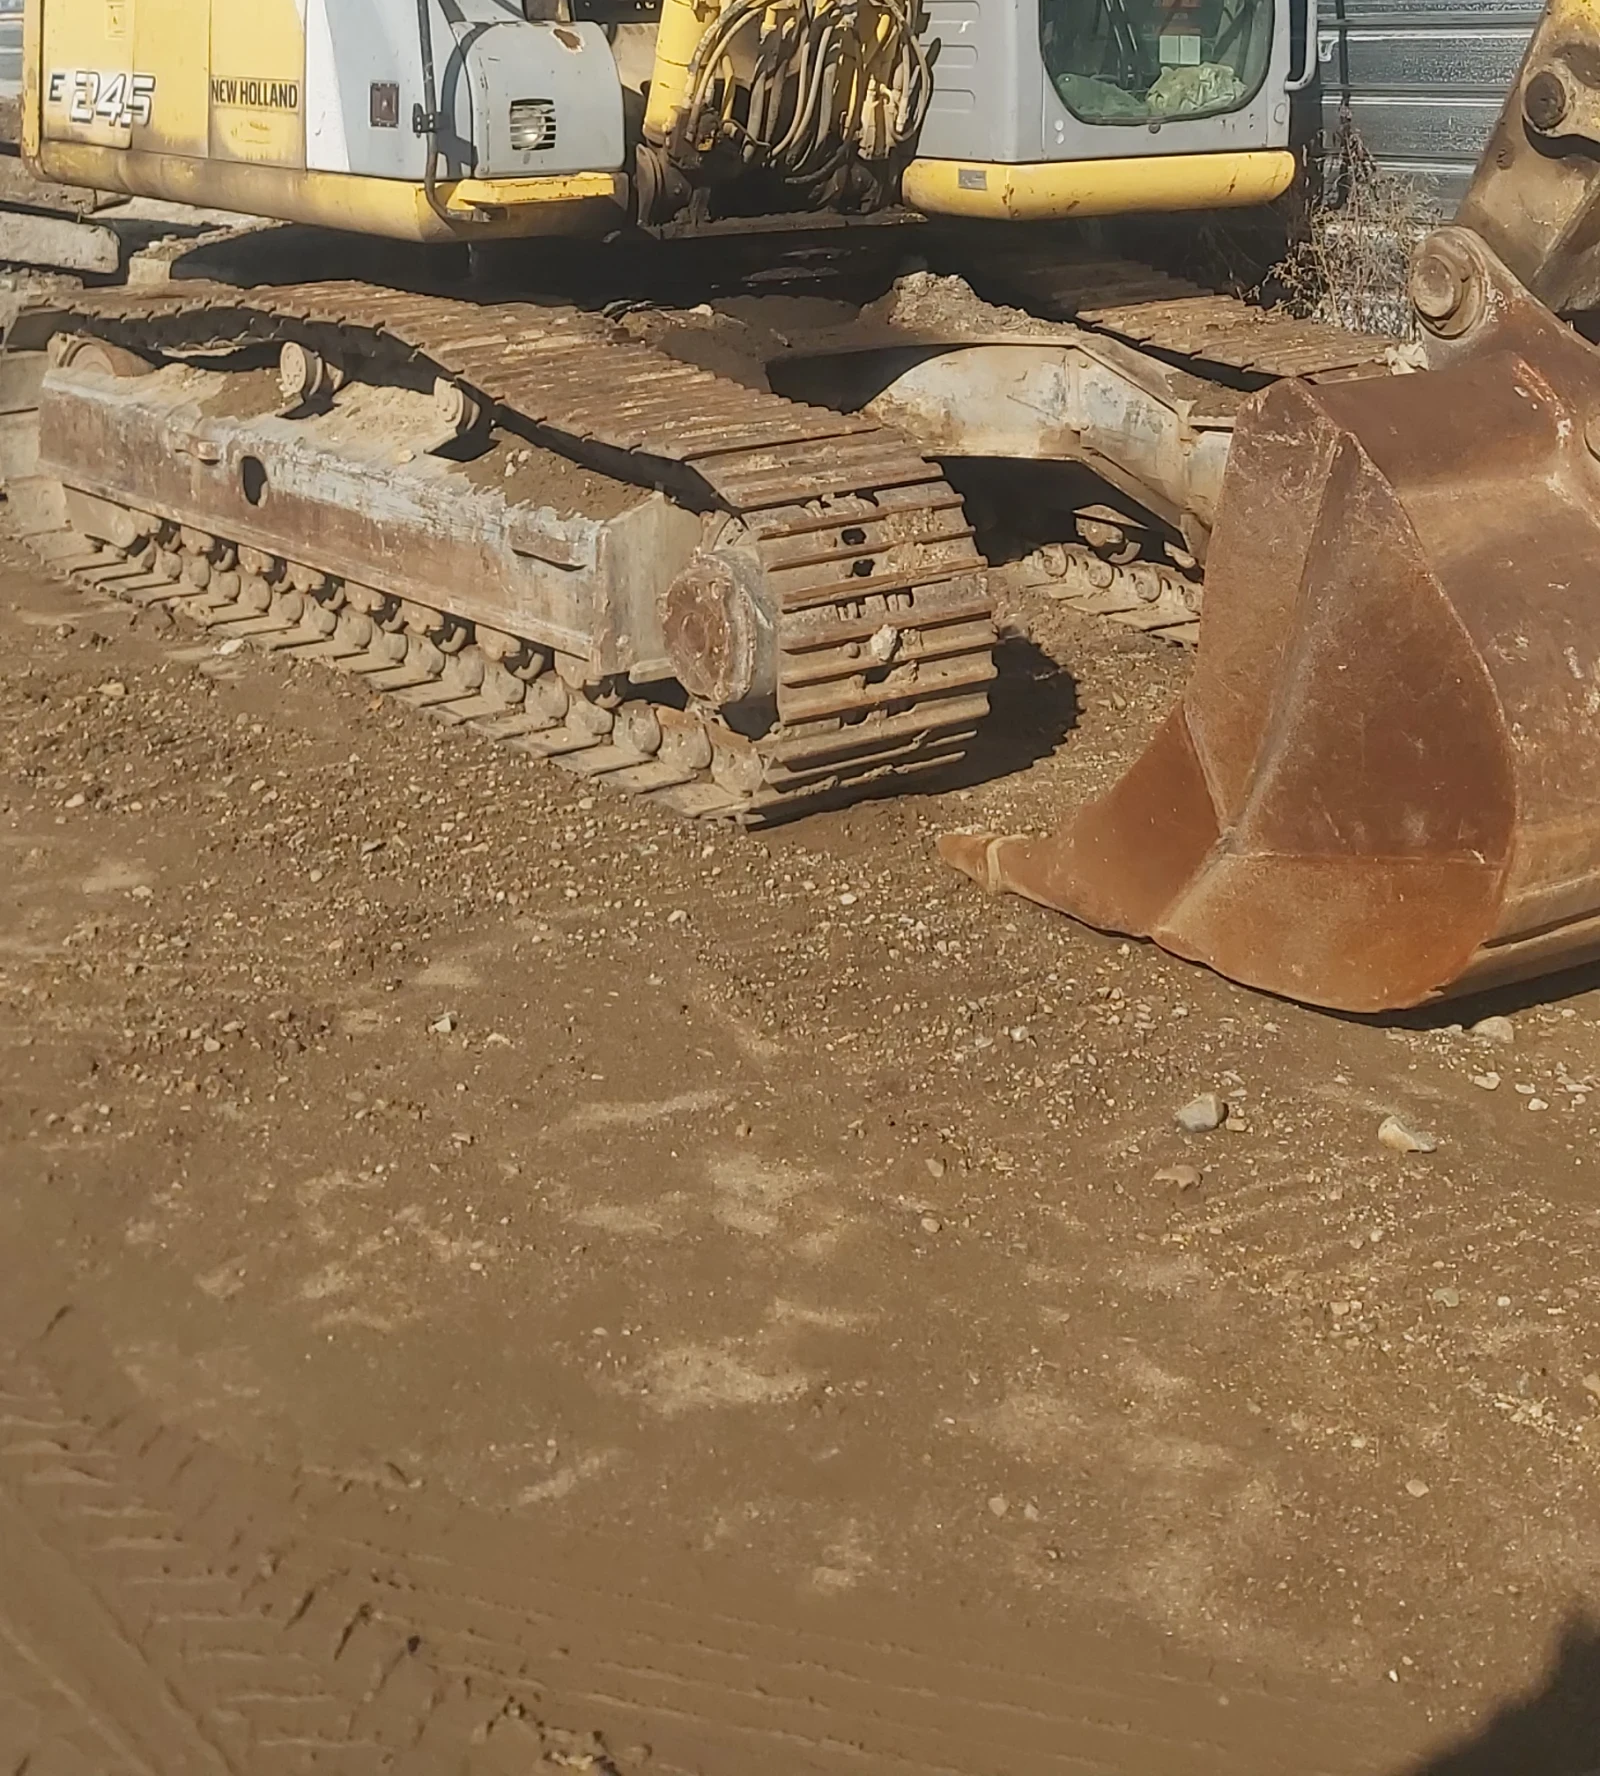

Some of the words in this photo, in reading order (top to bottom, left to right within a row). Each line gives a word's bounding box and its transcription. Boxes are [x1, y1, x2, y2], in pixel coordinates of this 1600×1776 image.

[49, 74, 65, 102] E
[70, 71, 156, 128] 245
[212, 79, 236, 103] NEW
[240, 81, 298, 109] HOLLAND
